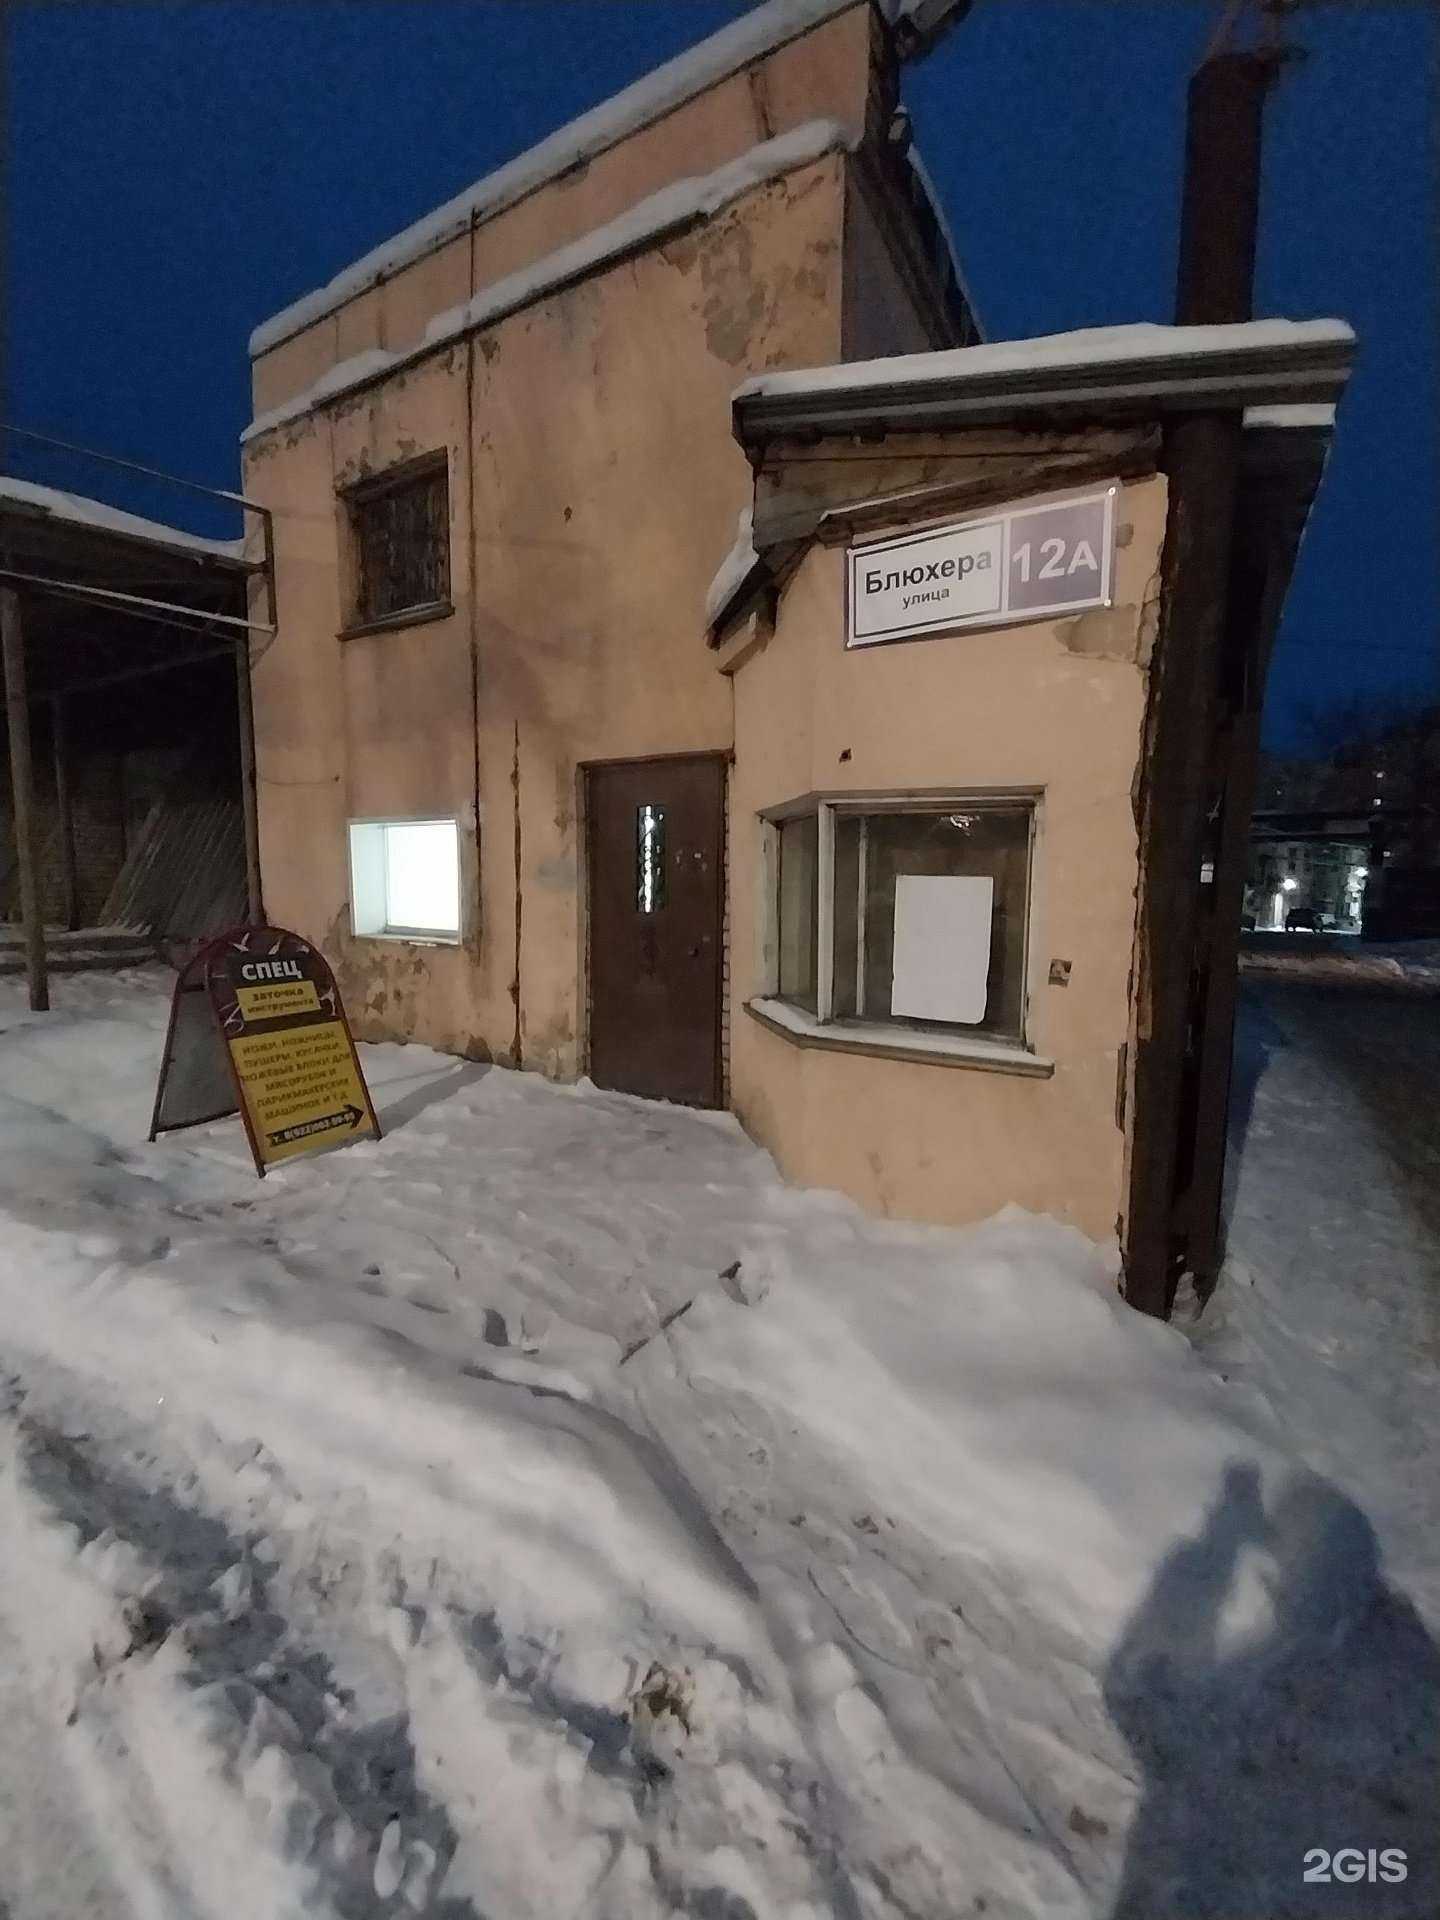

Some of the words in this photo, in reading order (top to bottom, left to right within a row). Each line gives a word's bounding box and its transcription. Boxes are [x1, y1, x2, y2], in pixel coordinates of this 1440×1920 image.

[865, 550, 992, 595] Блюхера
[1012, 537, 1098, 583] 12А
[903, 586, 950, 610] улица
[241, 960, 303, 981] СПЕЦ
